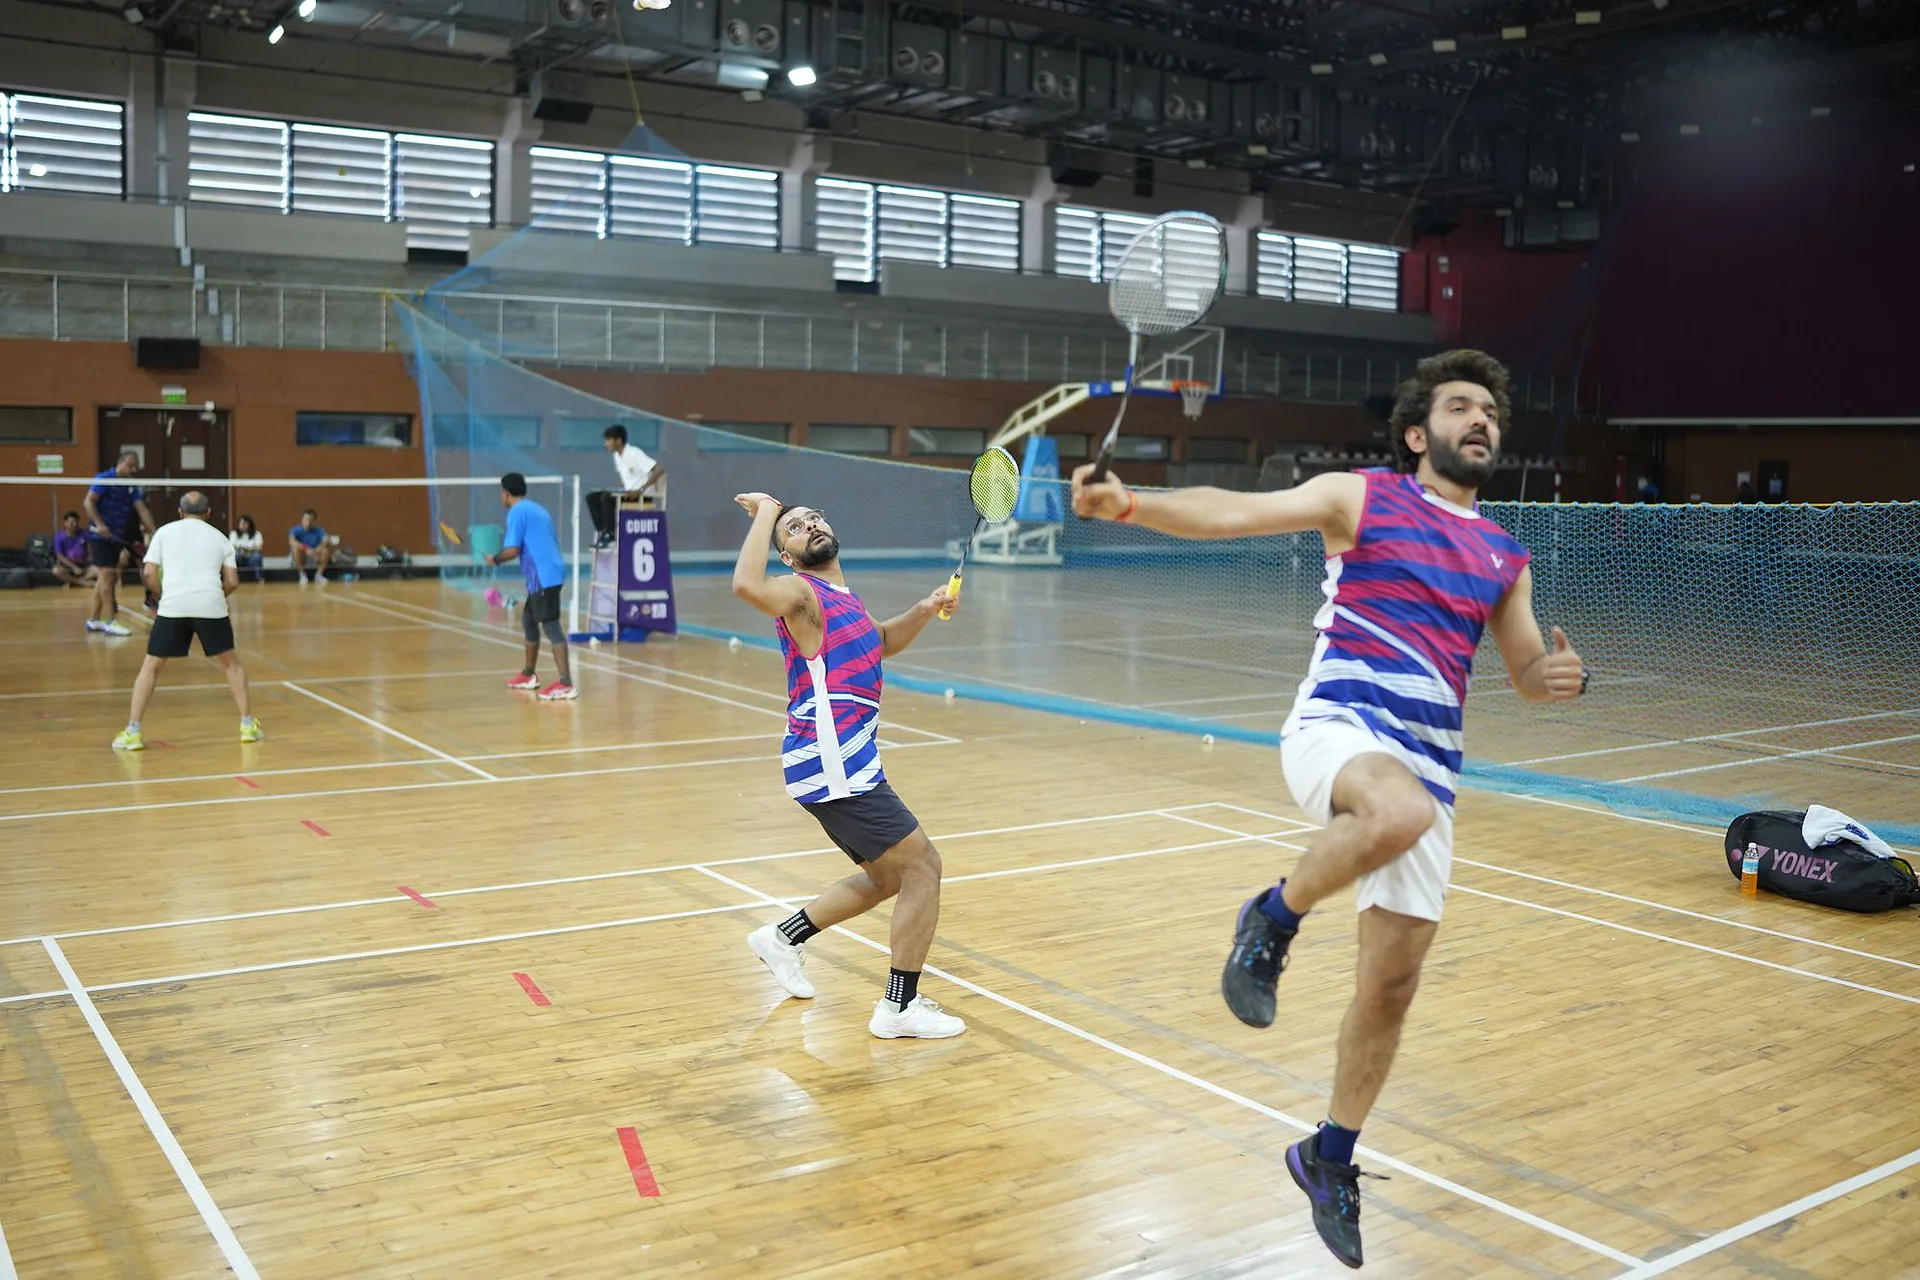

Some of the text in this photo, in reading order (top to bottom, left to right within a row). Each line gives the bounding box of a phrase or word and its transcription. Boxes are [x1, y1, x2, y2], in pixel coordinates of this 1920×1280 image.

[626, 519, 659, 534] COURT
[633, 538, 655, 582] 6
[1772, 849, 1839, 882] YONEX
